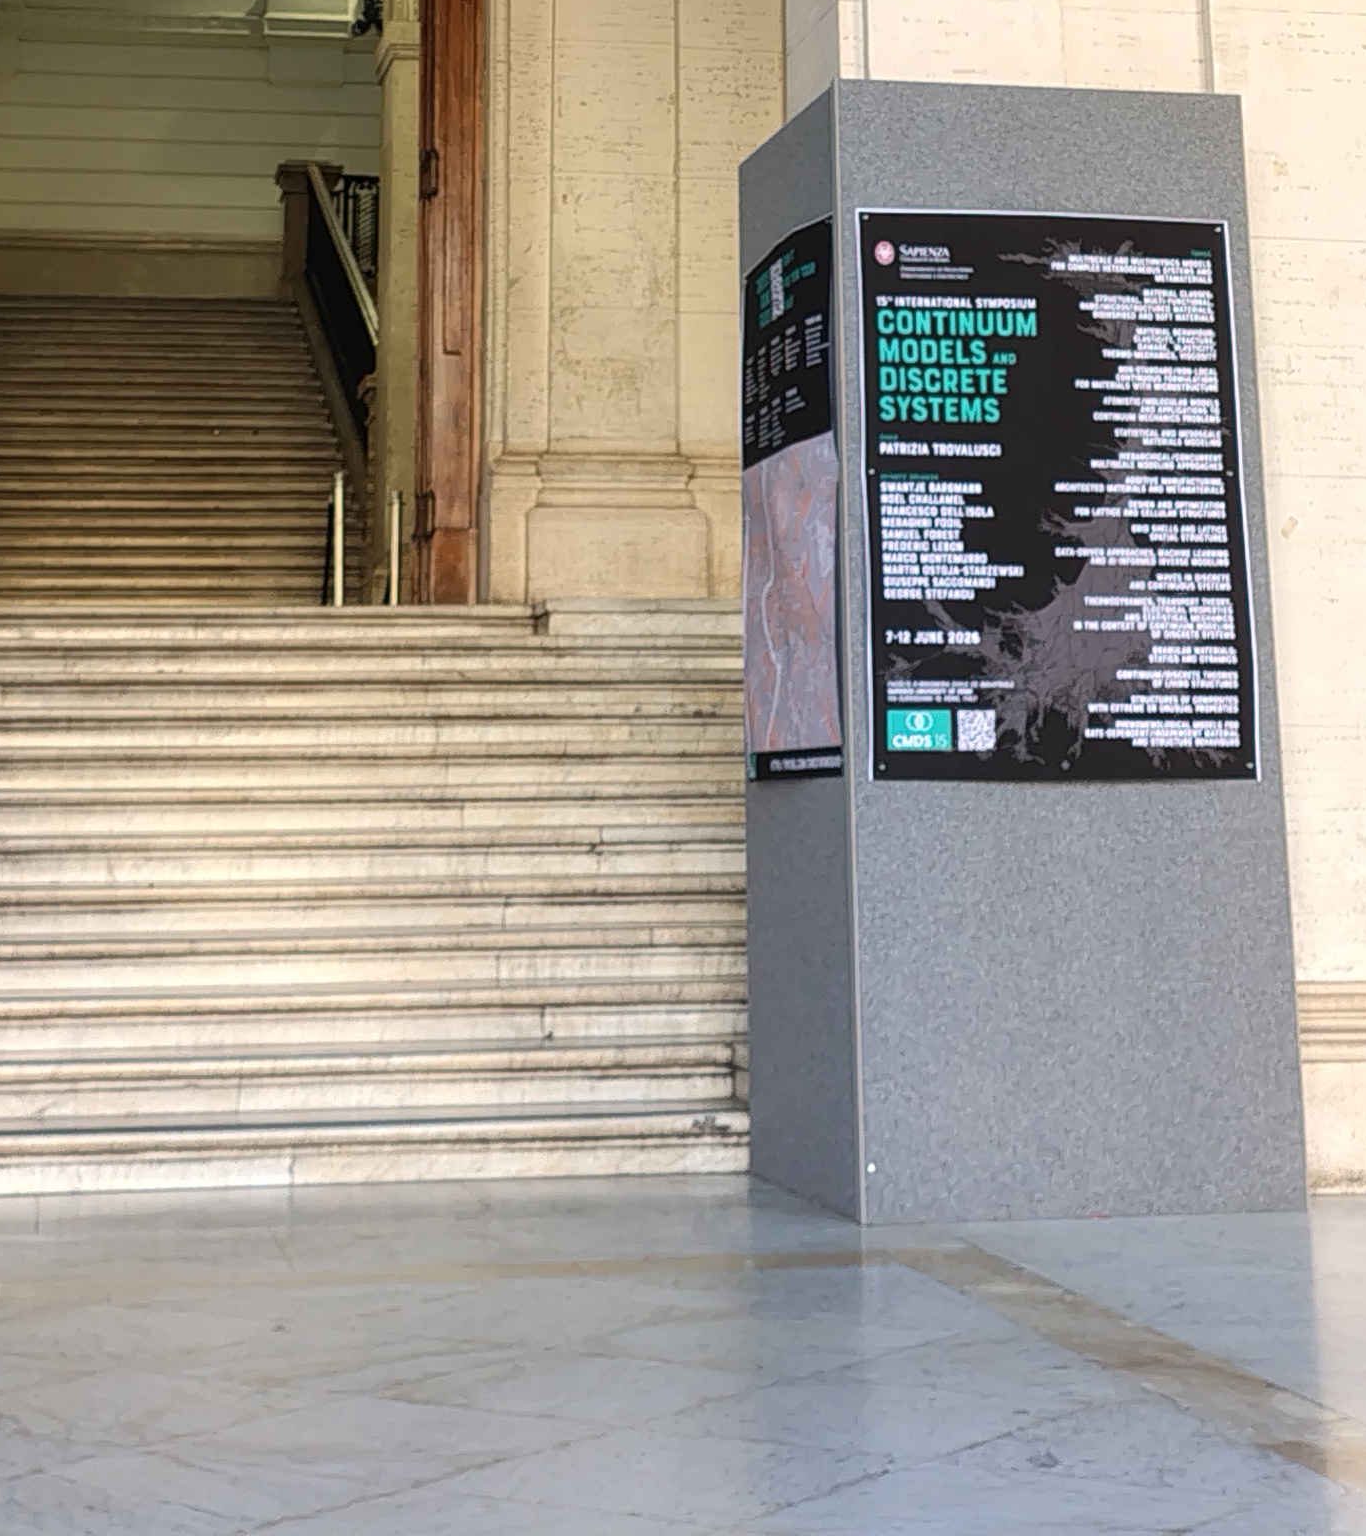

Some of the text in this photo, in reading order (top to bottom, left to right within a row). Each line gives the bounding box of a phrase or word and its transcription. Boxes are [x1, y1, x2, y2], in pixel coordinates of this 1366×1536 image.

[895, 296, 972, 308] INTERNATIONAL
[975, 298, 1036, 309] SYMPOSIUM
[877, 310, 1037, 336] CONTINUUM
[879, 338, 1017, 364] MODELS AND
[879, 366, 1007, 394] DISCRETE
[879, 395, 1000, 423] SYSTEMS
[879, 442, 1002, 457] PATRIZIA TROVALUSCI
[886, 630, 911, 644] 7-12
[914, 631, 944, 644] JUNE
[892, 734, 932, 747] CMDS
